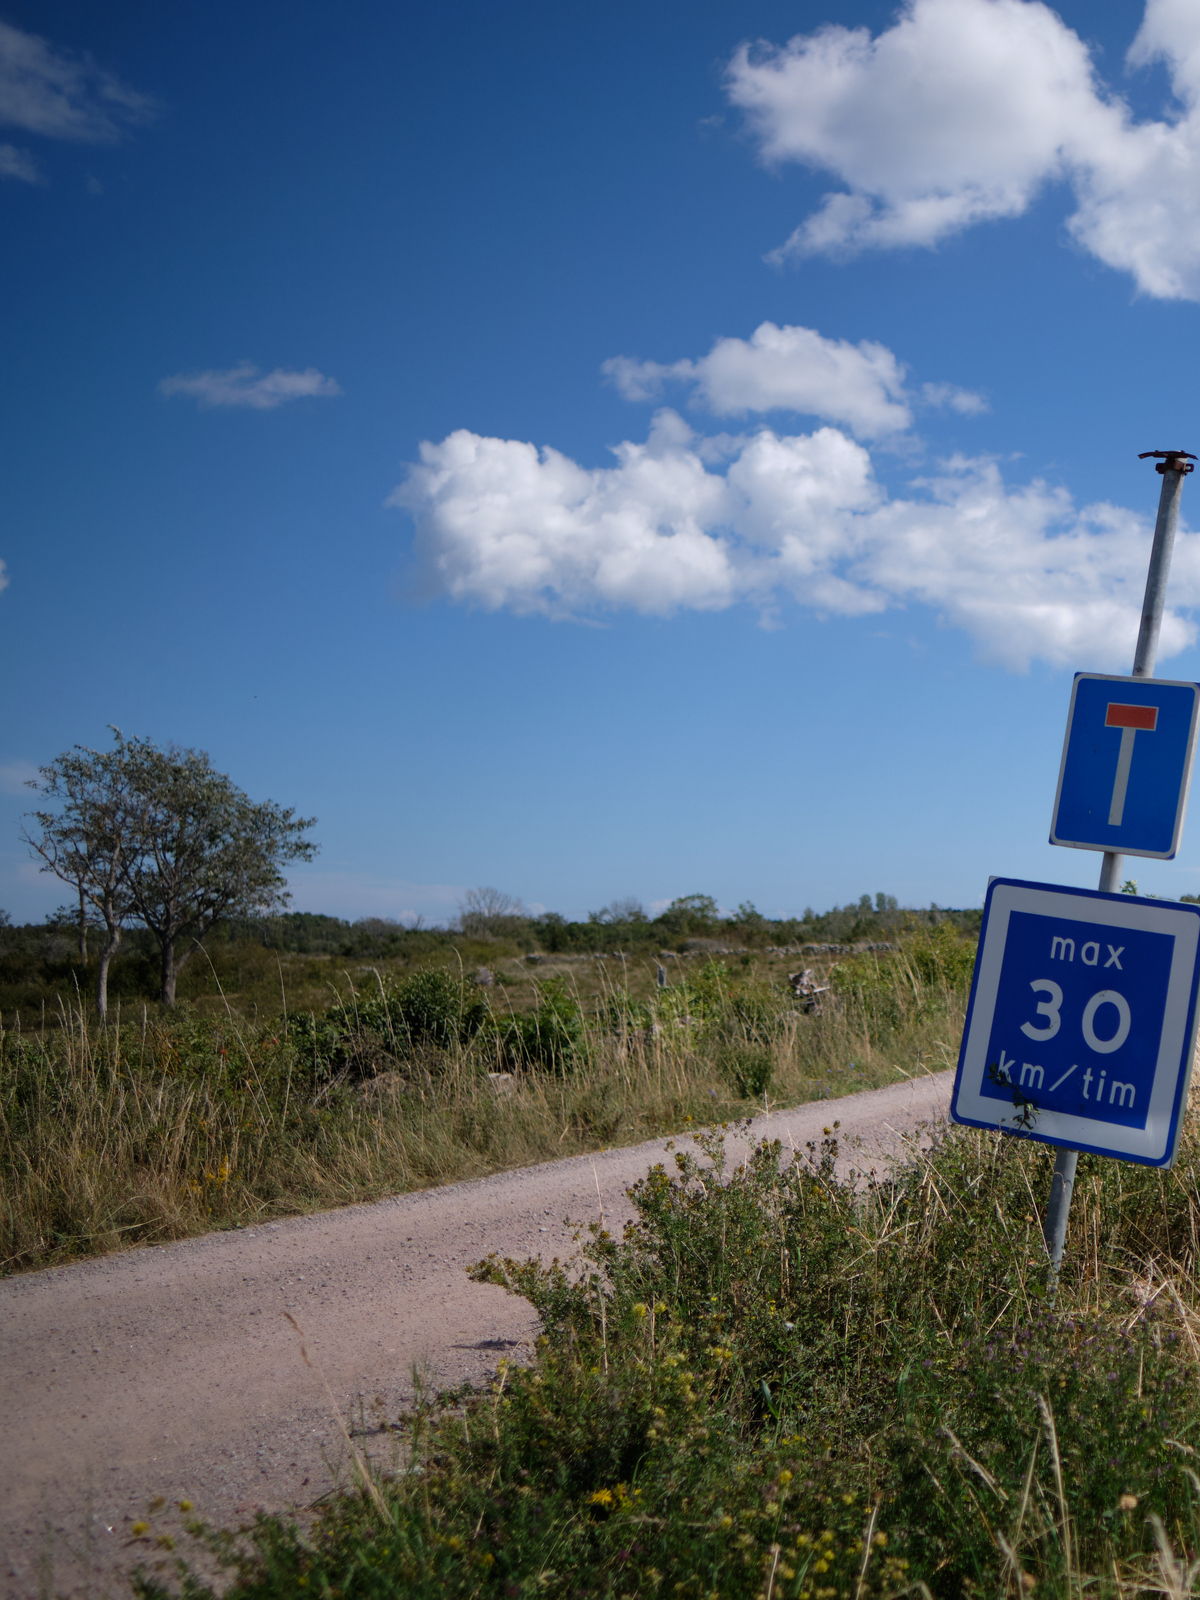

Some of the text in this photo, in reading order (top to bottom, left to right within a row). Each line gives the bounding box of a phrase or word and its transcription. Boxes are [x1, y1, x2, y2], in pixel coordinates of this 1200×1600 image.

[1050, 936, 1125, 970] max
[1020, 978, 1131, 1054] 30
[997, 1050, 1136, 1109] km/tim
